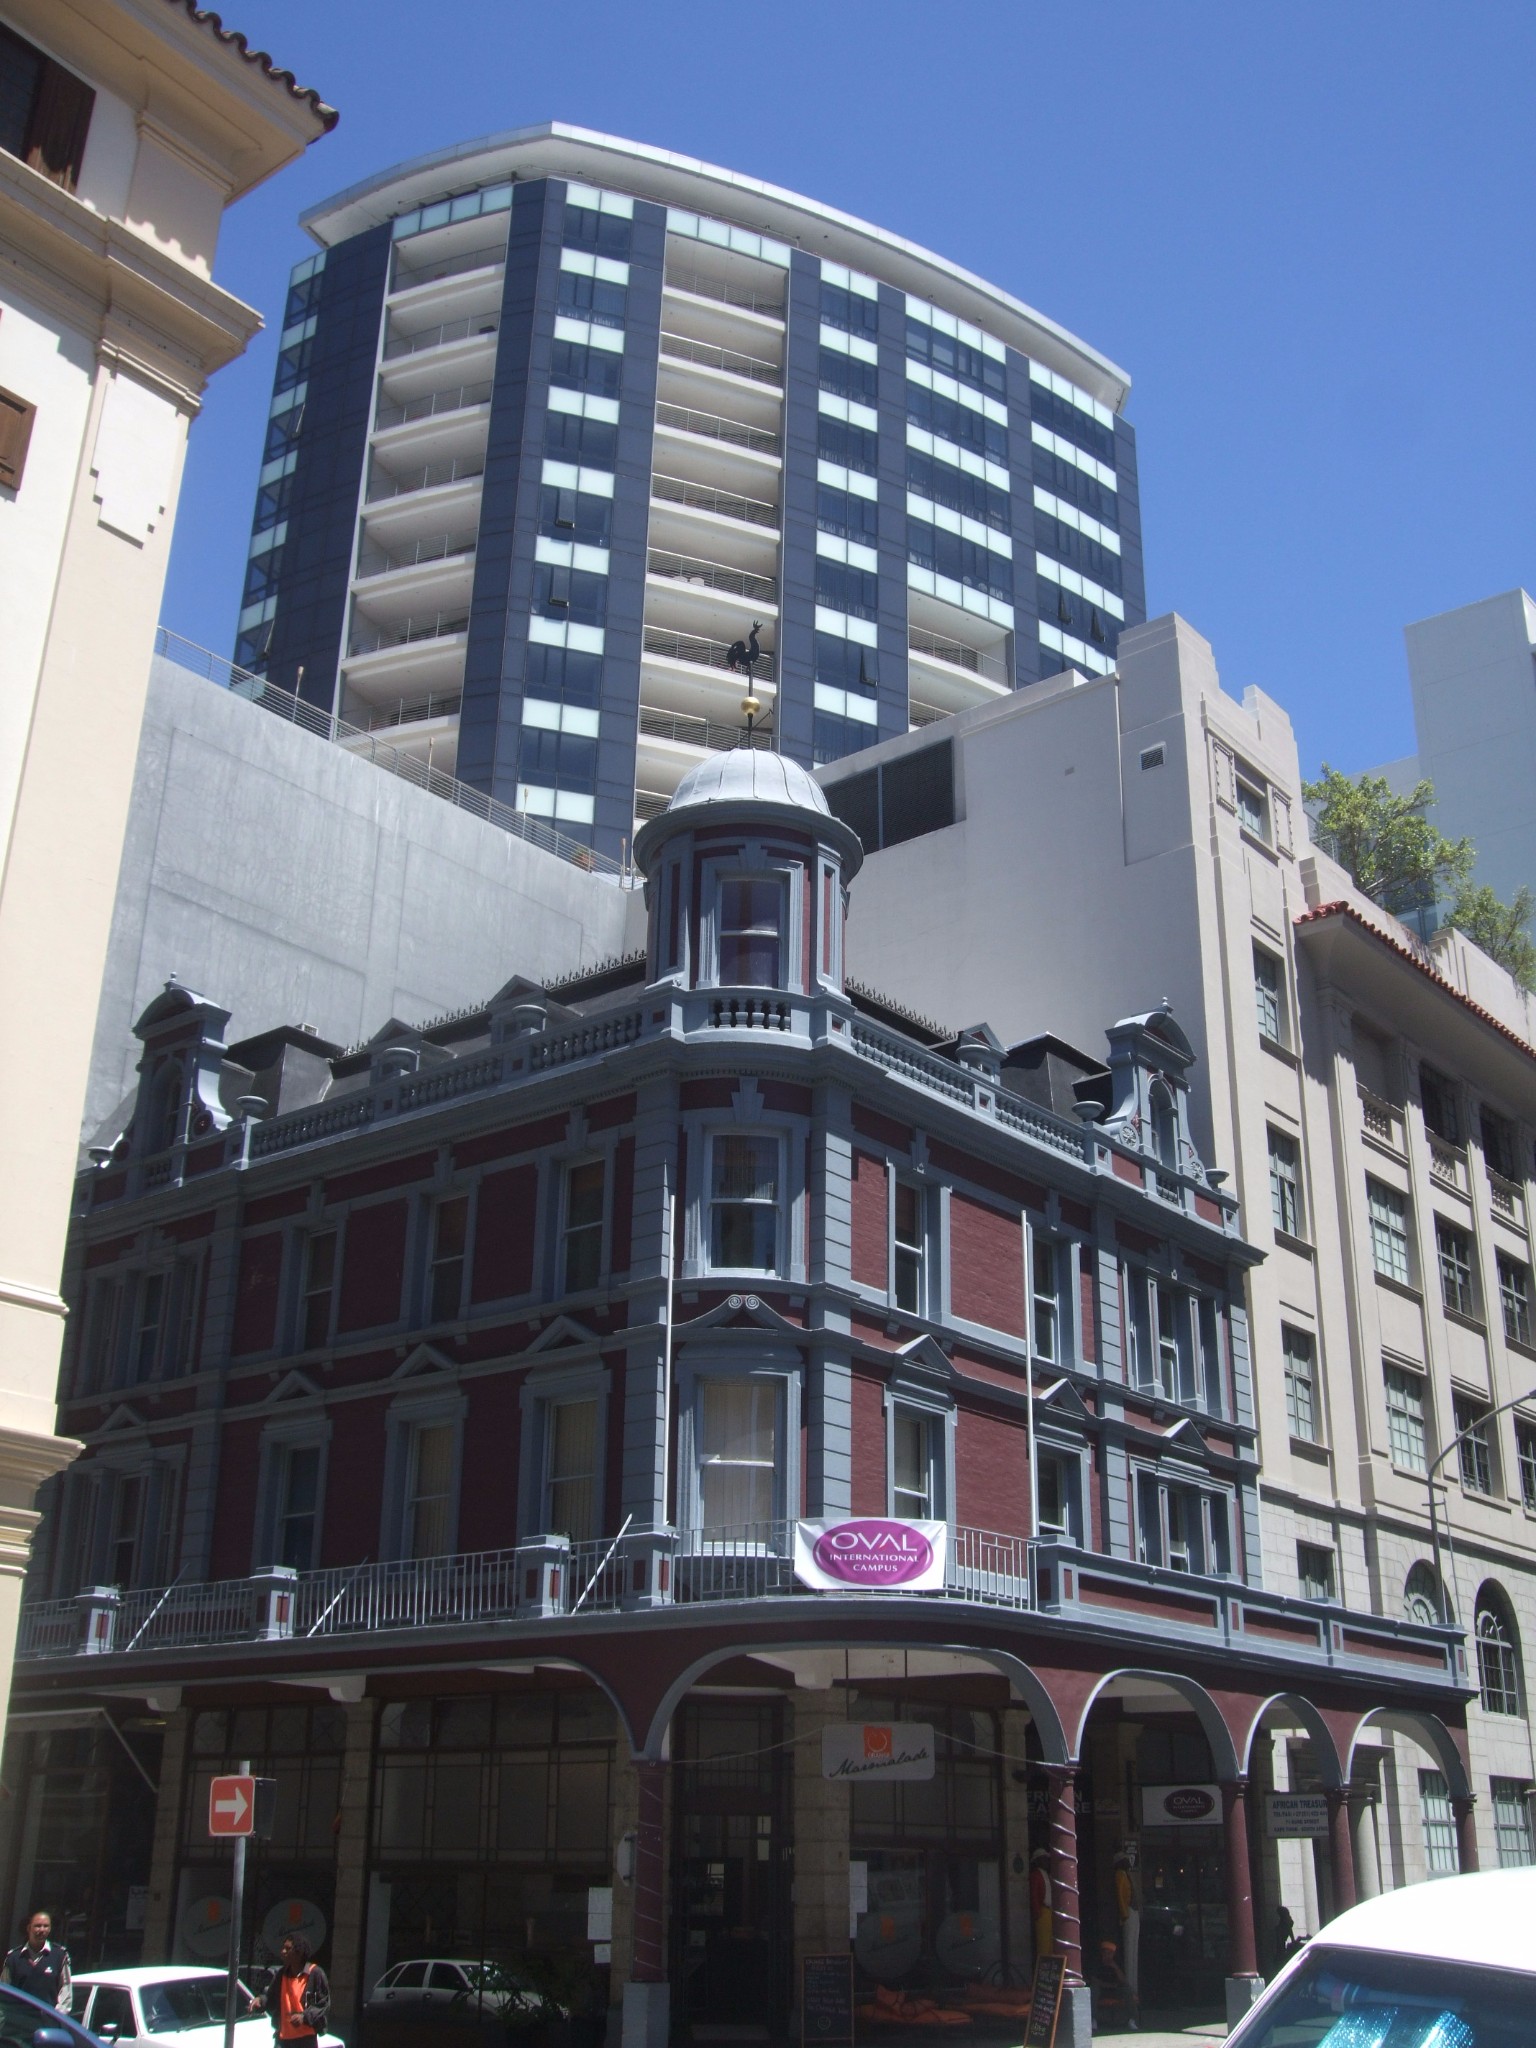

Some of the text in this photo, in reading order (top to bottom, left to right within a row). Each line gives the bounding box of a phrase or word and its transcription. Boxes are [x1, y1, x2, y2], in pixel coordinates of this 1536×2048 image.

[831, 1532, 918, 1552] OVAL
[829, 1553, 918, 1563] INTERNATIONAL
[852, 1564, 898, 1573] CAMPUS
[1173, 1797, 1205, 1805] OVAL
[1273, 1800, 1328, 1809] AFRICAN TREASUR
